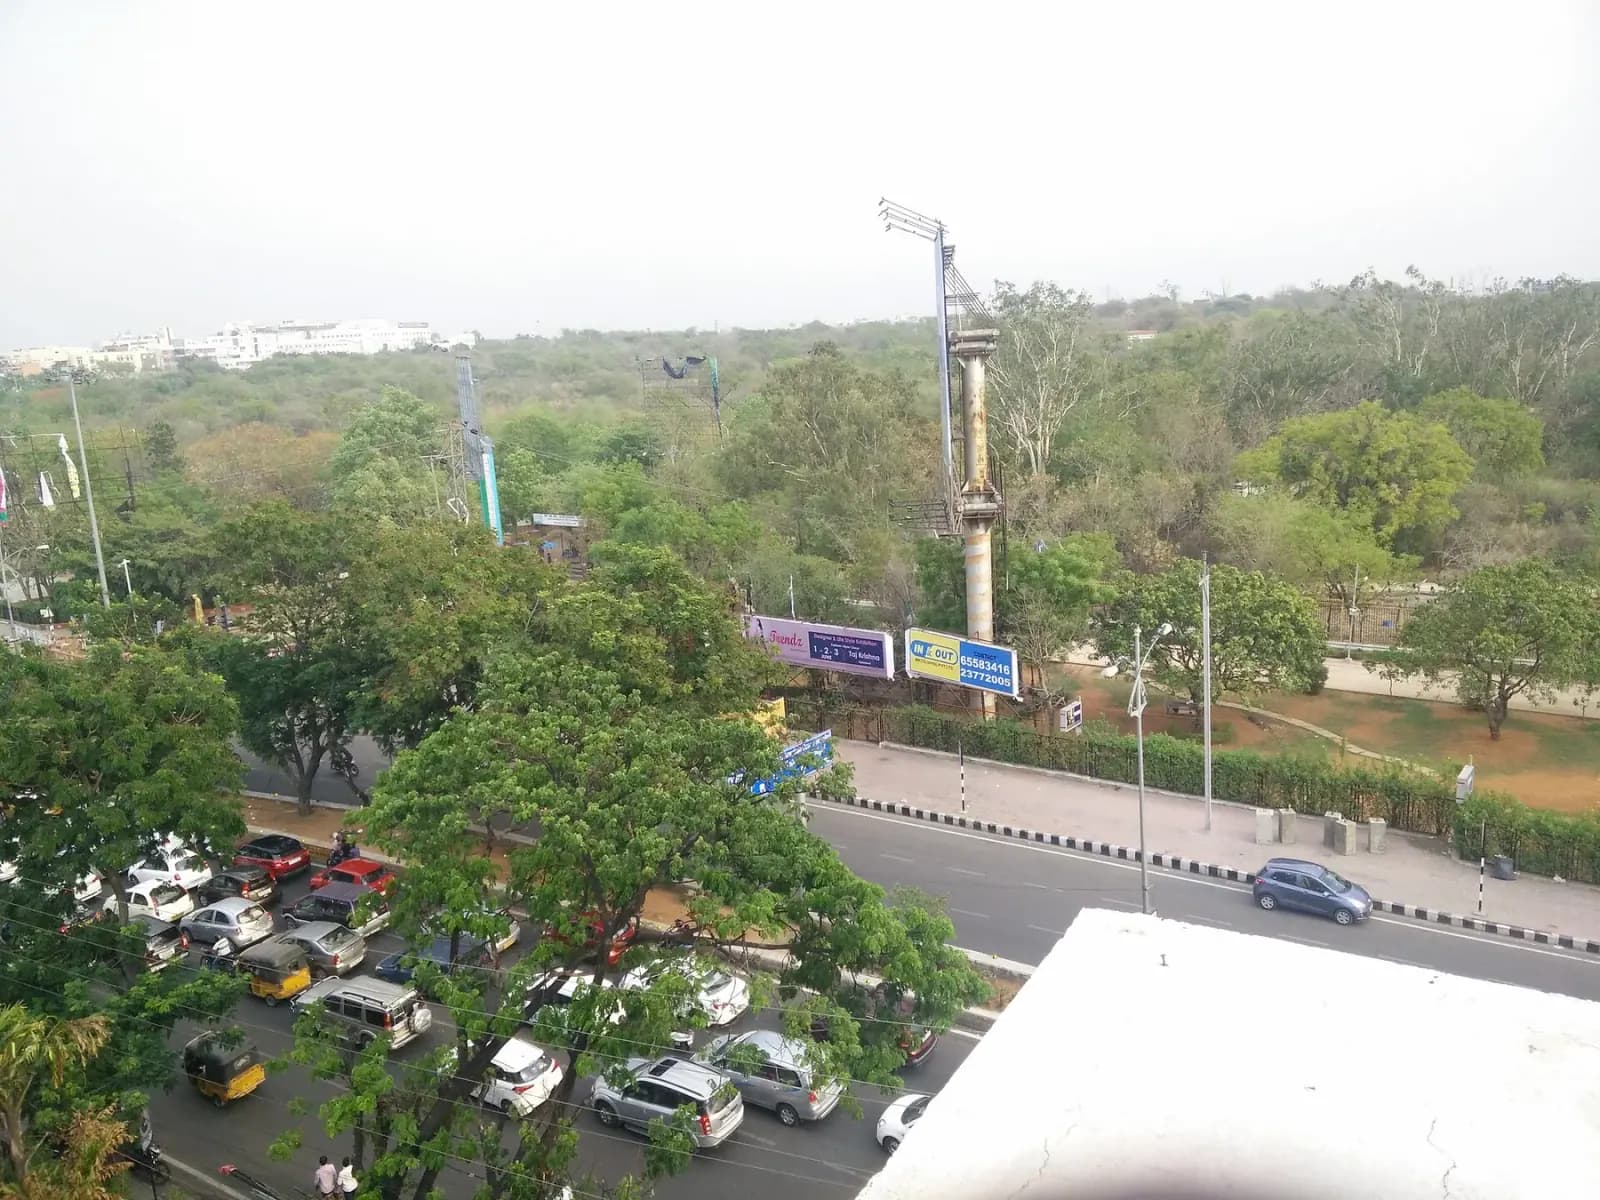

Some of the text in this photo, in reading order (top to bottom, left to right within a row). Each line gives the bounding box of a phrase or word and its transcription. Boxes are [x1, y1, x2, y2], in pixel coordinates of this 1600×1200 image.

[914, 644, 924, 655] IN
[935, 649, 954, 660] OUT
[960, 655, 1010, 675] 65583416
[960, 668, 1011, 687] 23772005
